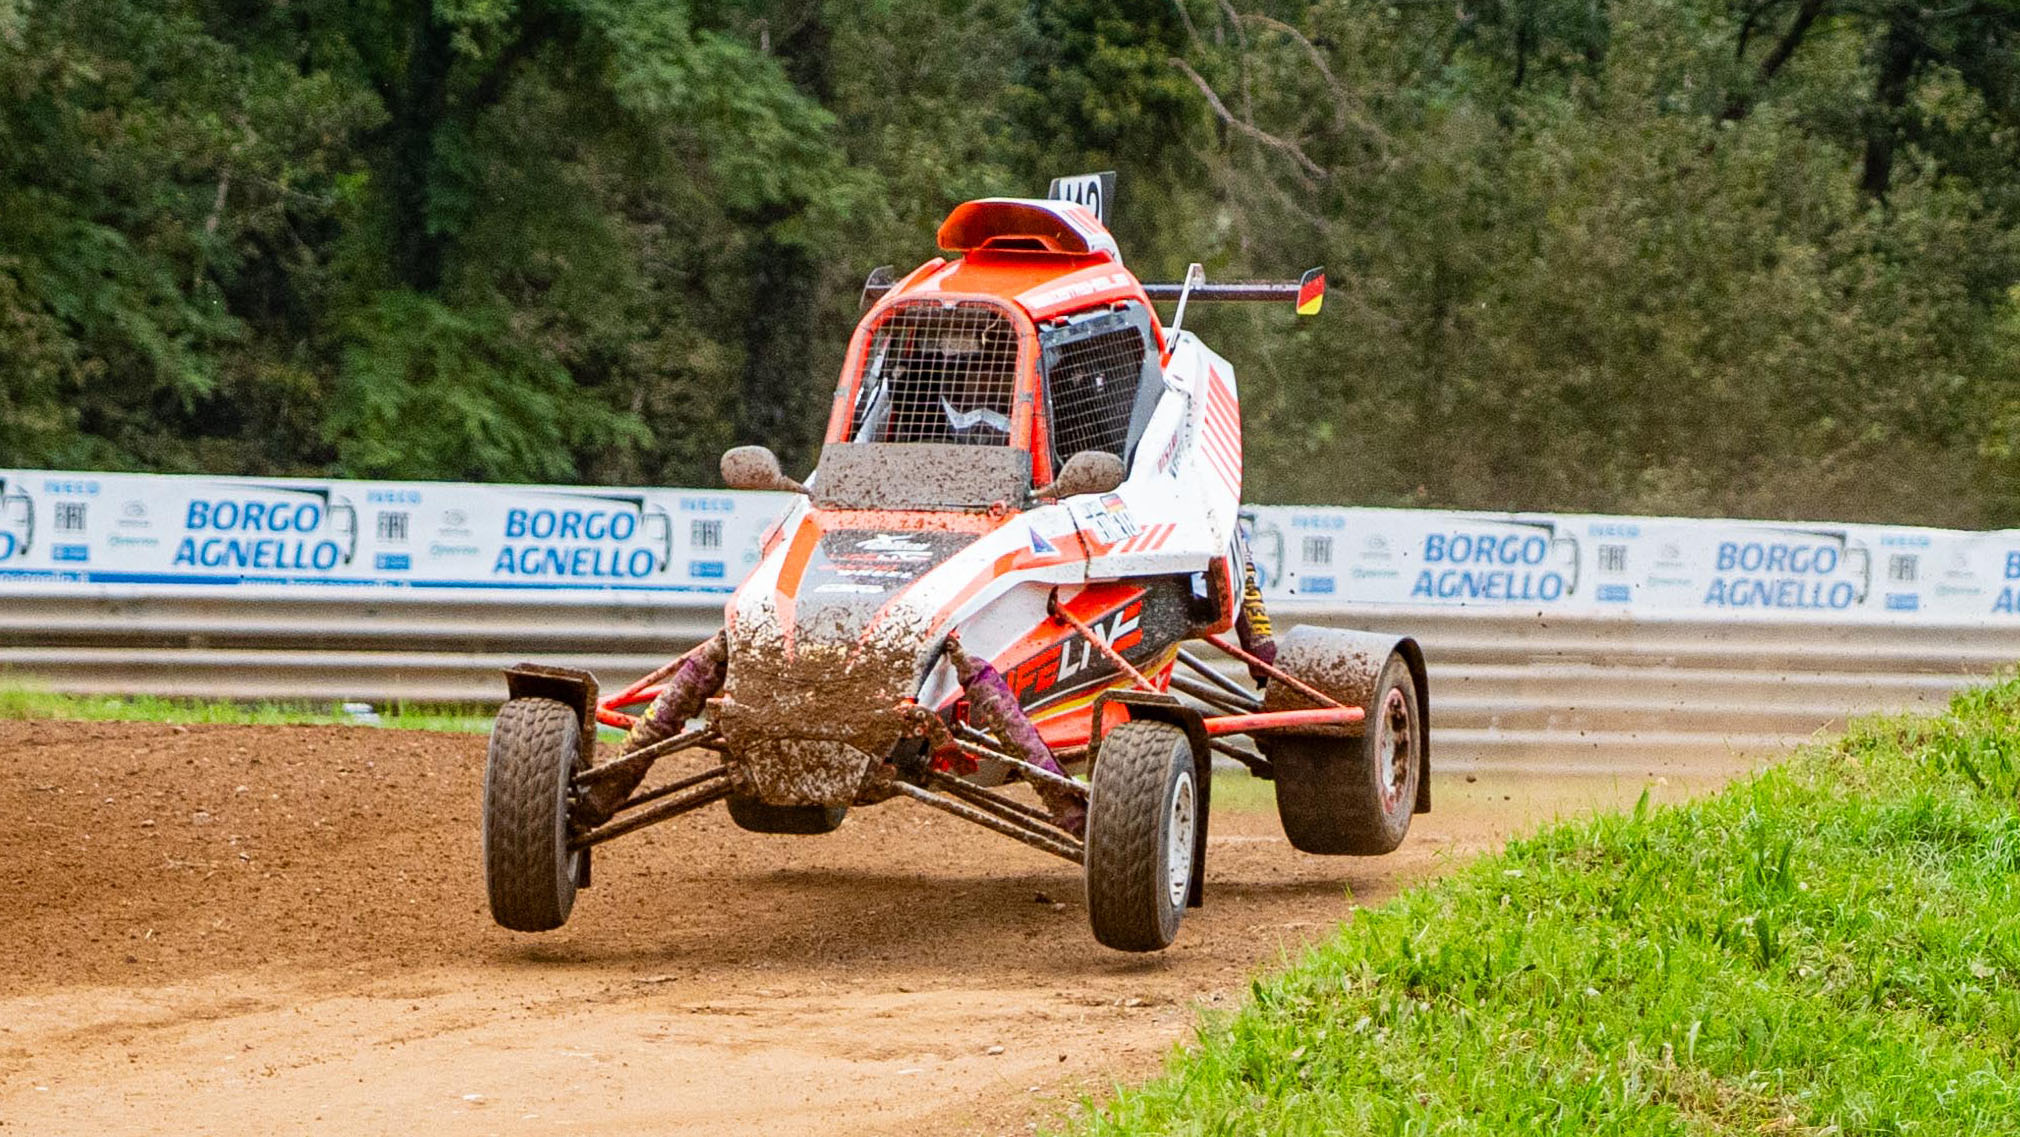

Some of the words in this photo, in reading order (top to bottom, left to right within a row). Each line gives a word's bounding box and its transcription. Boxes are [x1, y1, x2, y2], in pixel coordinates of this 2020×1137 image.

[186, 500, 320, 533] BORGO
[506, 508, 636, 541] BORGO
[173, 536, 340, 570] AGNELLO
[494, 545, 654, 578] AGNELLO
[1425, 533, 1547, 565] BORGO
[1716, 542, 1838, 574] BORGO
[1411, 569, 1562, 601] AGNELLO
[1704, 578, 1854, 610] AGNELLO
